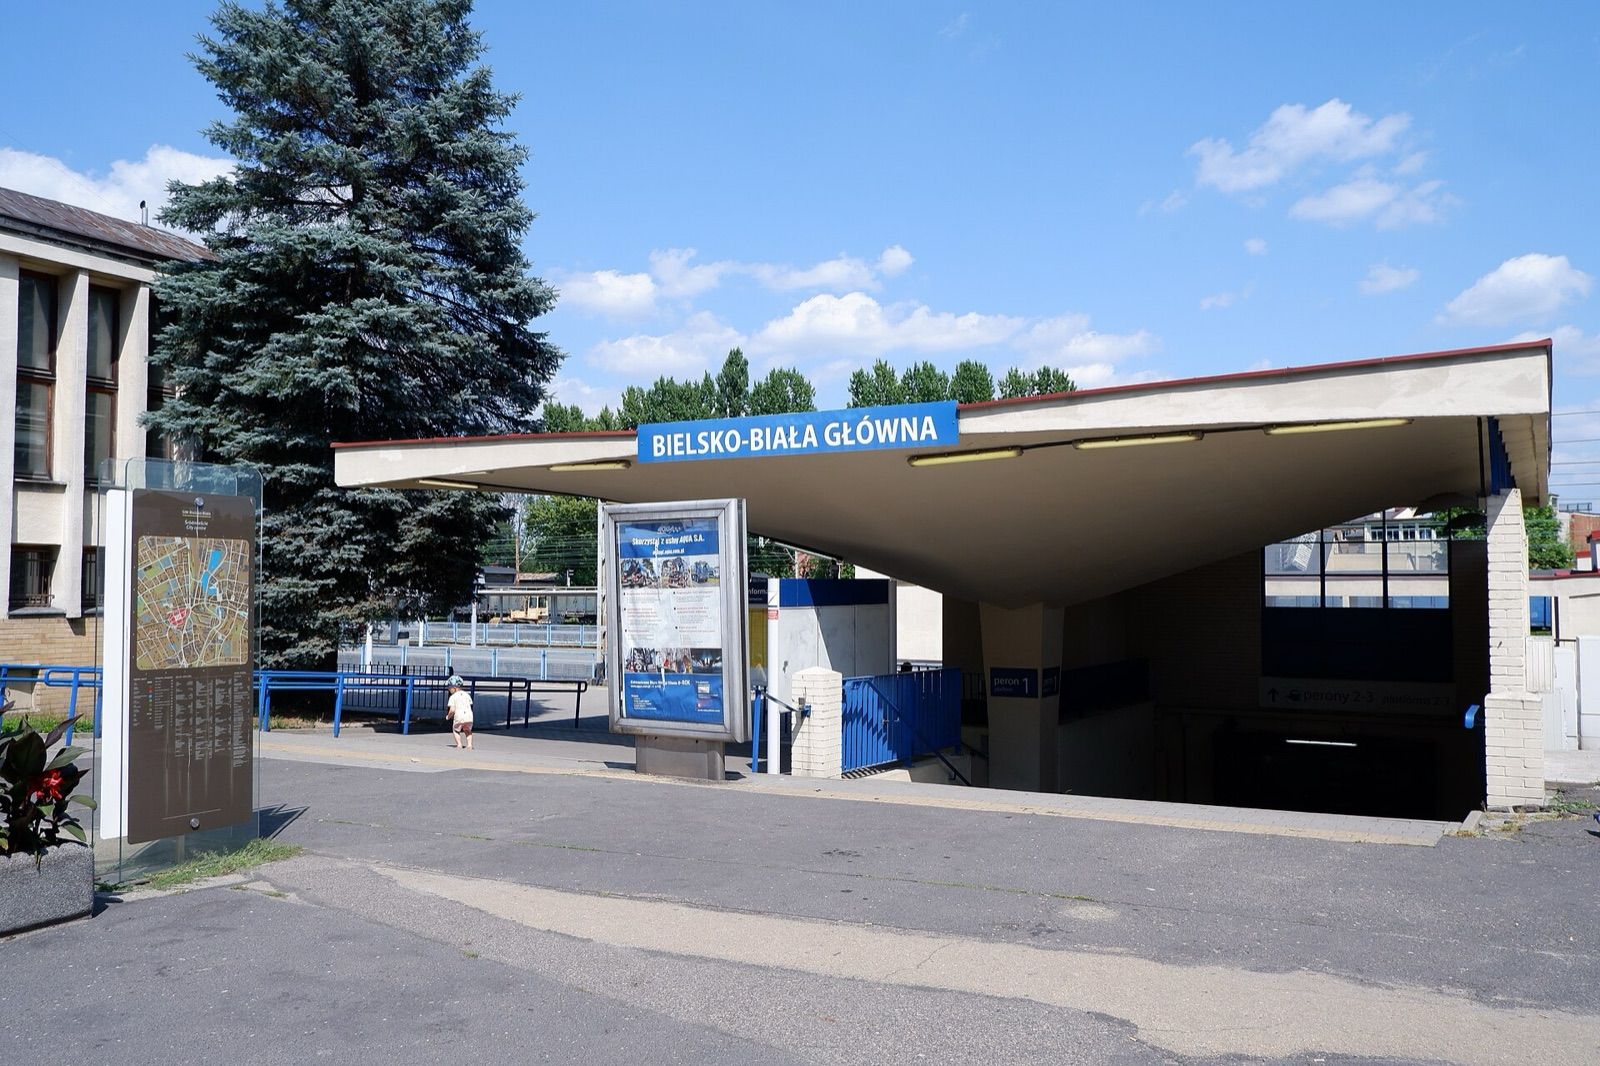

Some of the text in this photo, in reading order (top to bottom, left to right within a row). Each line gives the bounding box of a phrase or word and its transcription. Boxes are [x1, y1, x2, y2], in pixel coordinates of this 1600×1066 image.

[652, 415, 938, 457] BIELSKO-BIAŁA GŁÓWNA
[693, 533, 705, 542] S.A.
[994, 677, 1020, 687] peron
[1022, 676, 1029, 695] 1
[1304, 688, 1350, 705] perony
[1353, 690, 1375, 704] 2-3
